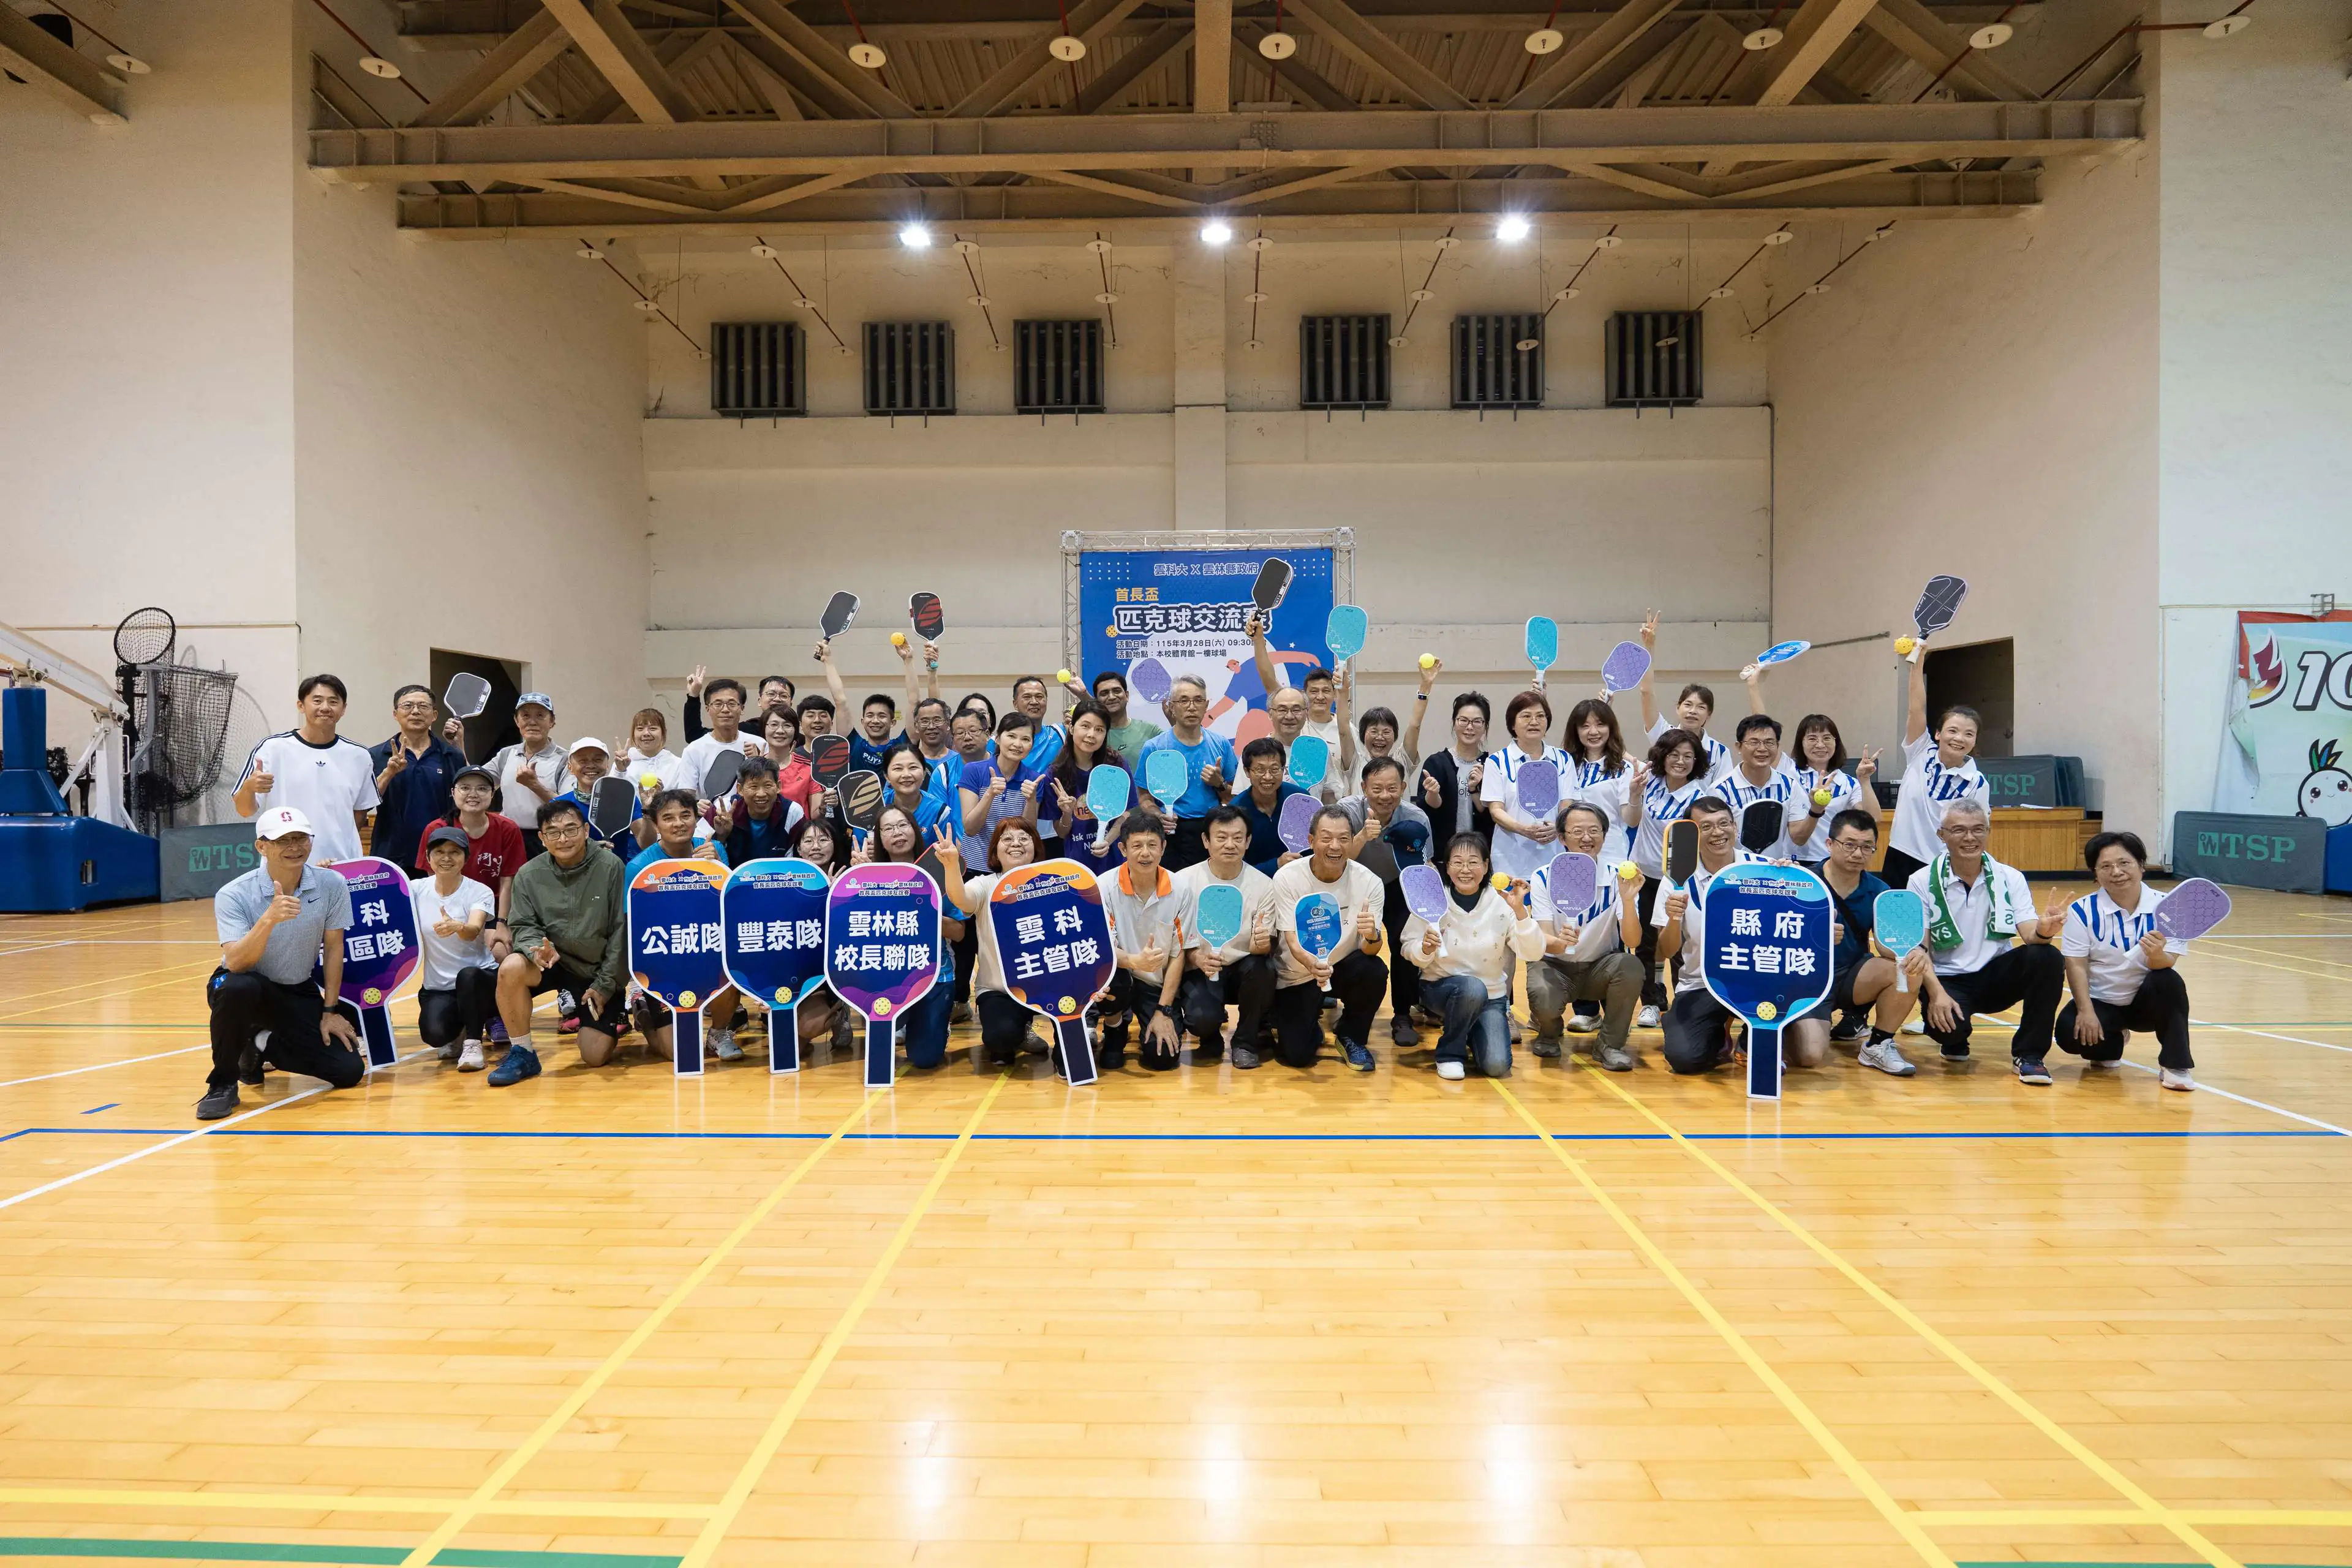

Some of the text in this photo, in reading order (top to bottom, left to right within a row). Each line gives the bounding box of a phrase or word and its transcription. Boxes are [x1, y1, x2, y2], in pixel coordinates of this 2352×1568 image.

[1154, 564, 1188, 576] 雲科大
[1203, 563, 1259, 575] 雲林縣政府
[1115, 587, 1159, 601] 首長盃
[1988, 774, 2035, 796] TSP
[189, 841, 261, 872] WTS
[737, 919, 822, 953] 豐泰隊
[849, 910, 919, 937] 雲林縣
[343, 929, 405, 962] 區隊
[835, 944, 930, 971] 校長聯隊
[1014, 938, 1101, 979] 主管隊
[1719, 943, 1815, 976] 主管隊
